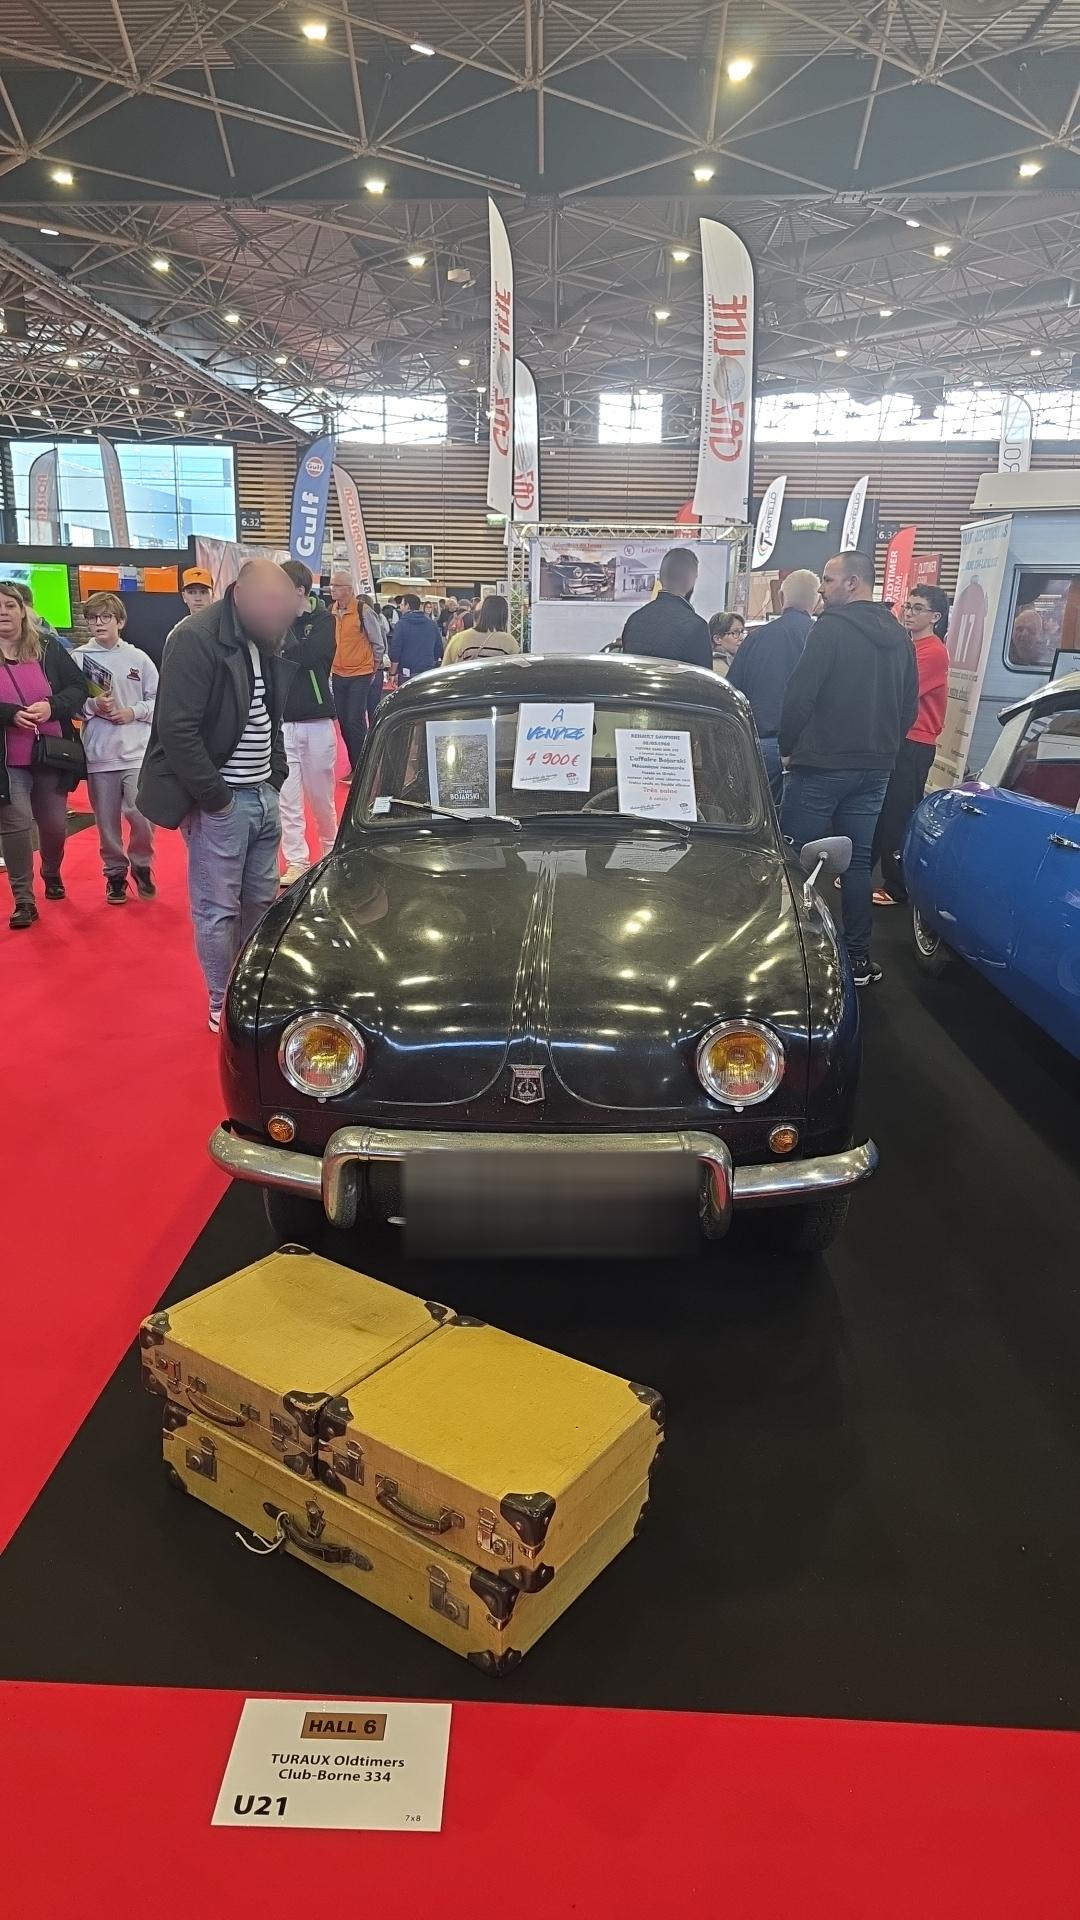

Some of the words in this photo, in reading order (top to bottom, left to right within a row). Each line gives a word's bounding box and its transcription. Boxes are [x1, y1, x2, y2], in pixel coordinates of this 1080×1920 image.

[306, 462, 323, 471] Gulf
[241, 517, 260, 527] 6.32
[296, 491, 319, 557] Gulf
[760, 491, 777, 546] TURATELLO
[552, 708, 564, 722] A
[527, 726, 585, 740] VENDRE
[541, 752, 580, 766] 900€
[308, 1719, 357, 1734] HALL
[363, 1719, 377, 1735] 6
[271, 1753, 330, 1766] TURAUX
[334, 1755, 405, 1768] Oldtimers
[278, 1768, 361, 1782] Club-Borne
[364, 1771, 392, 1783] 334
[233, 1794, 288, 1817] U21
